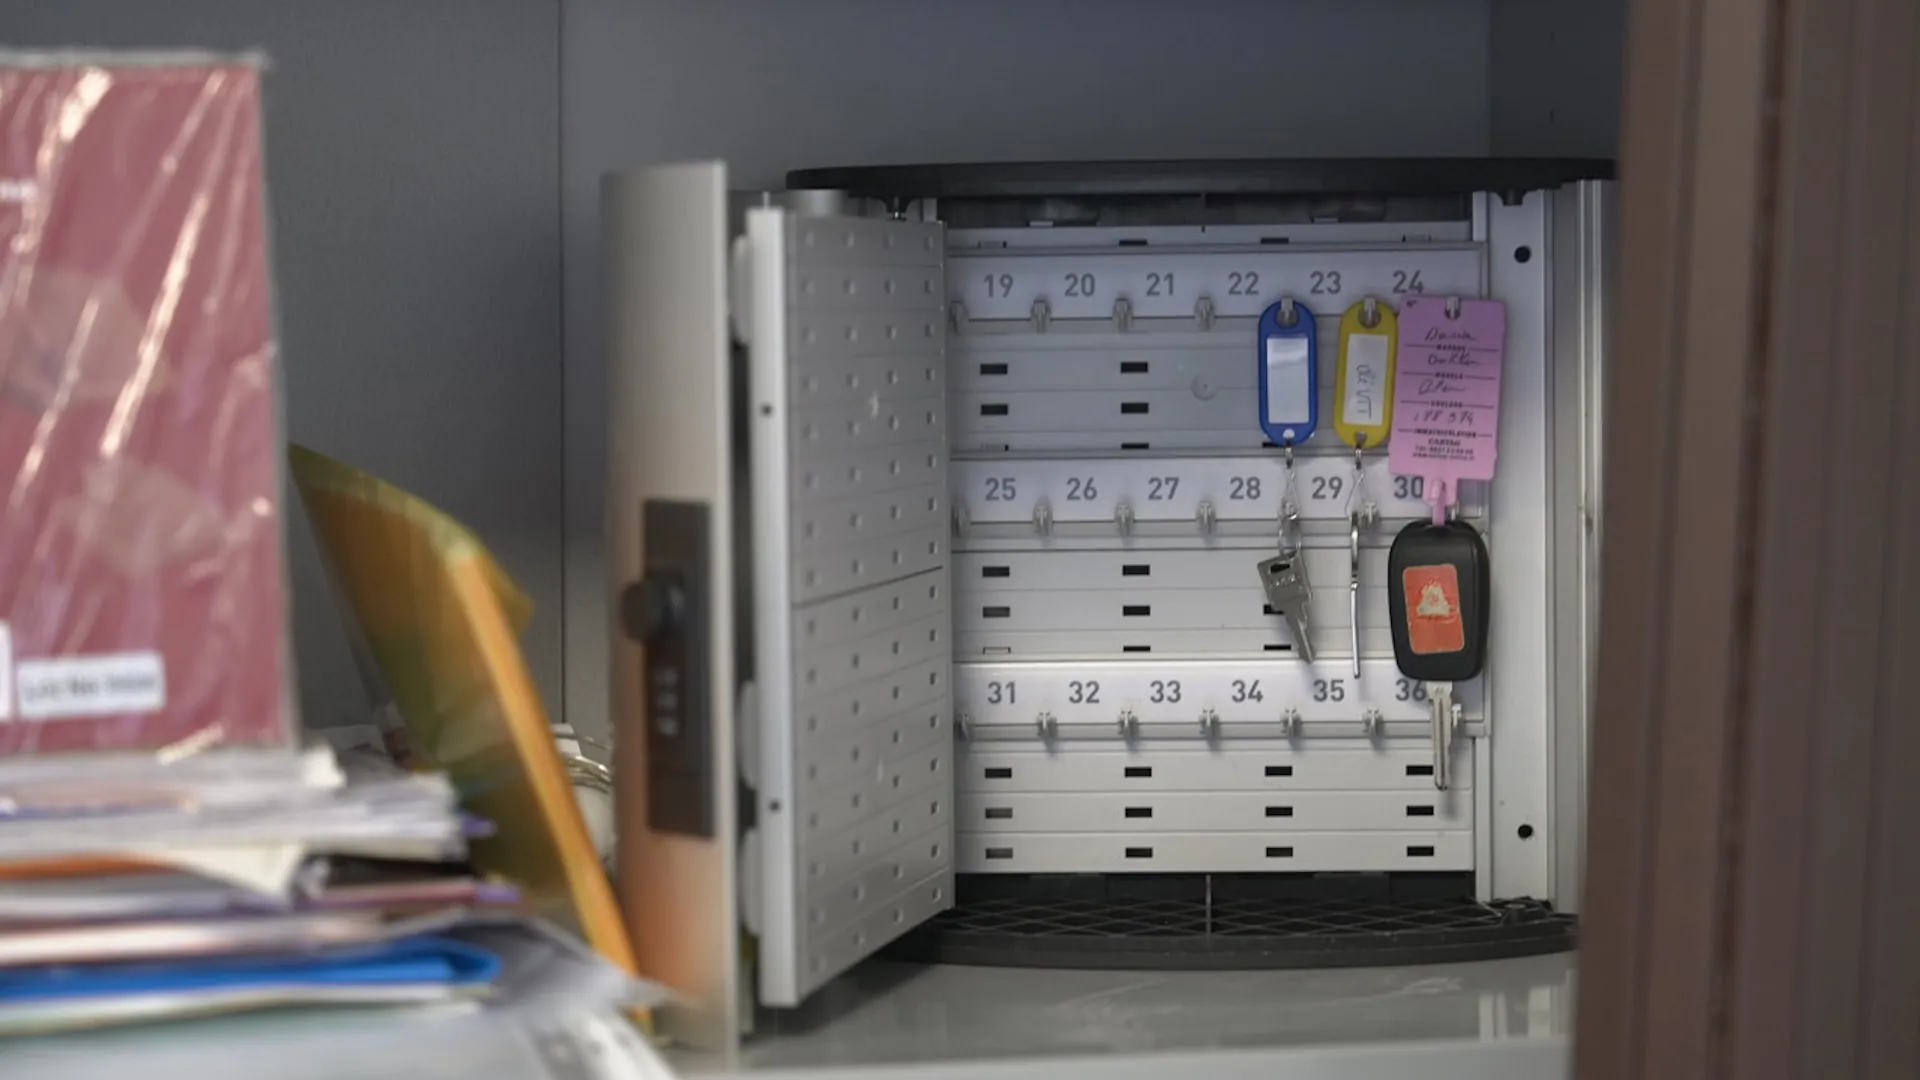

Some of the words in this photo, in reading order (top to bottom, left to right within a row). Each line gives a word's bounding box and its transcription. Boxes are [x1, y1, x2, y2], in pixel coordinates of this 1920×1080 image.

[983, 274, 1014, 297] 19
[1065, 273, 1095, 296] 20
[1146, 273, 1174, 295] 21
[1228, 272, 1259, 295] 22
[1310, 271, 1341, 294] 23
[1392, 270, 1424, 294] 24
[985, 477, 1015, 500] 25
[1066, 477, 1097, 500] 26
[1148, 476, 1180, 500] 27
[1229, 476, 1261, 500] 28
[1311, 476, 1343, 499] 29
[1393, 475, 1424, 499] 30
[986, 681, 1016, 704] 31
[1068, 680, 1100, 704] 32
[1149, 680, 1182, 704] 33
[1231, 679, 1264, 703] 34
[1312, 679, 1345, 703] 35
[1395, 678, 1427, 702] 36
